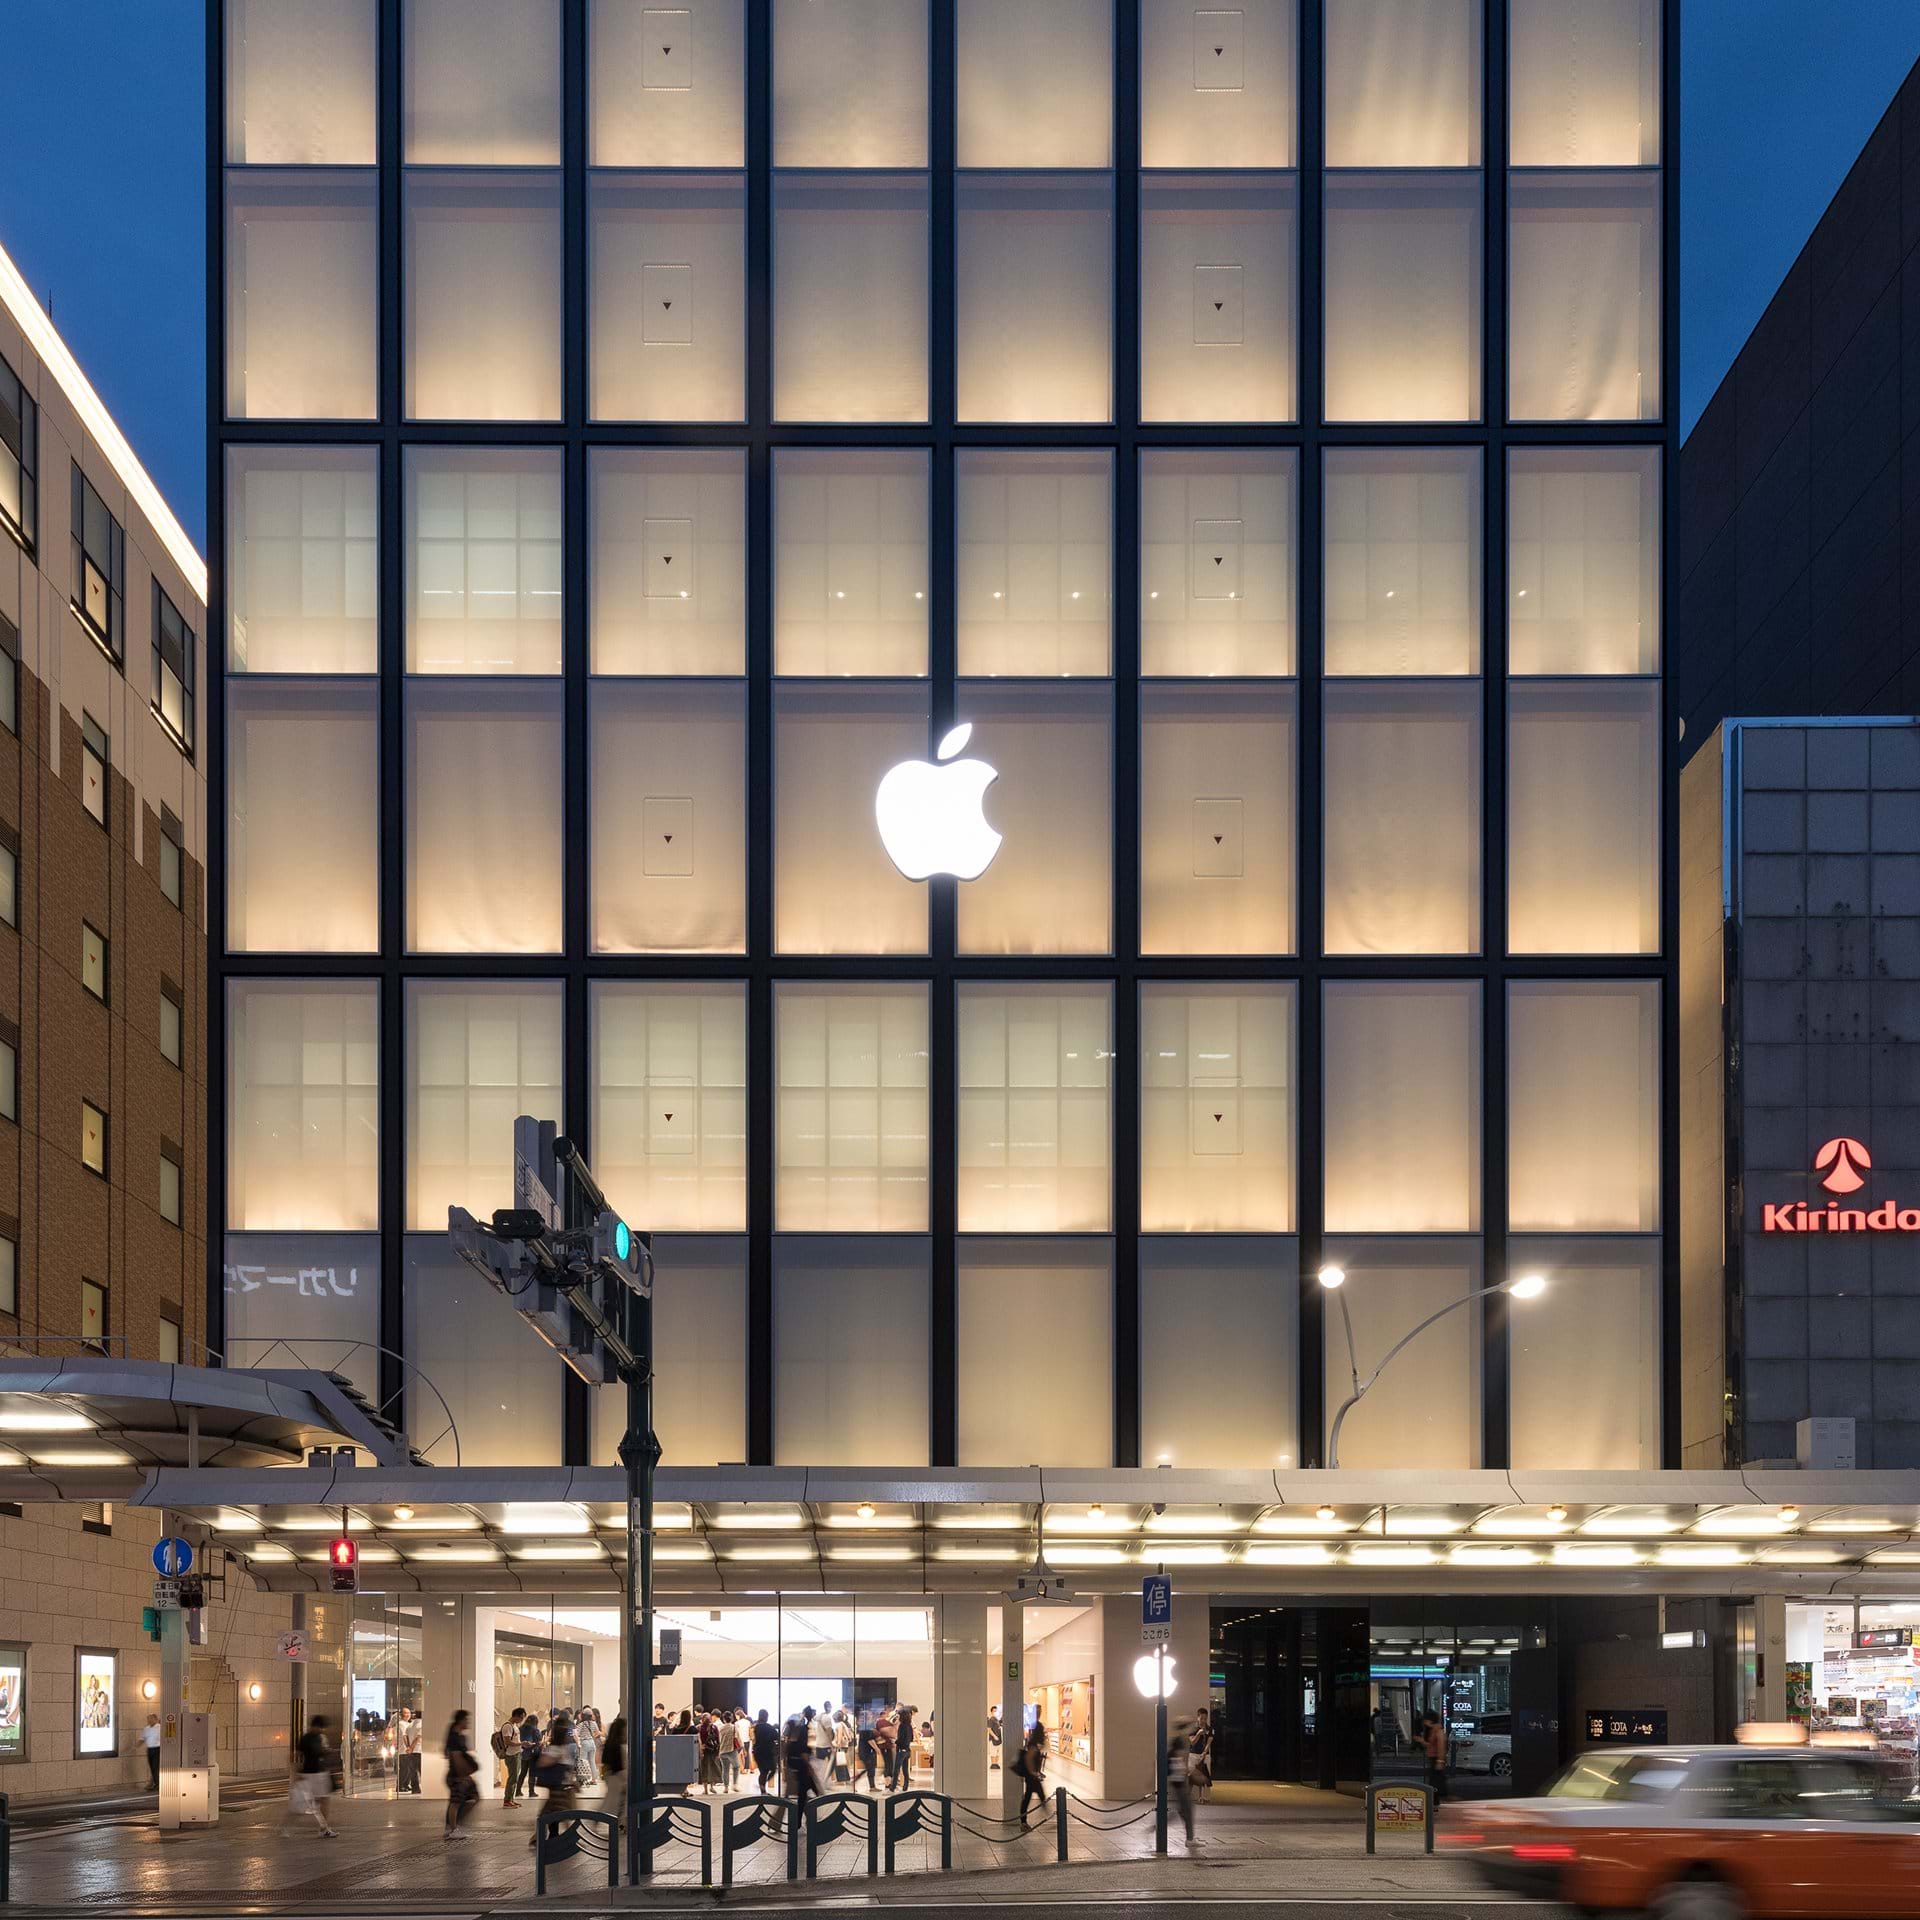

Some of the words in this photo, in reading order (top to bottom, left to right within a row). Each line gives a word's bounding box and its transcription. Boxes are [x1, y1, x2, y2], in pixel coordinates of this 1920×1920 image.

[1763, 1200, 1920, 1231] Kirindo
[1146, 1583, 1167, 1616] 停
[1142, 1628, 1170, 1640] ここから
[1610, 1721, 1628, 1731] COTA
